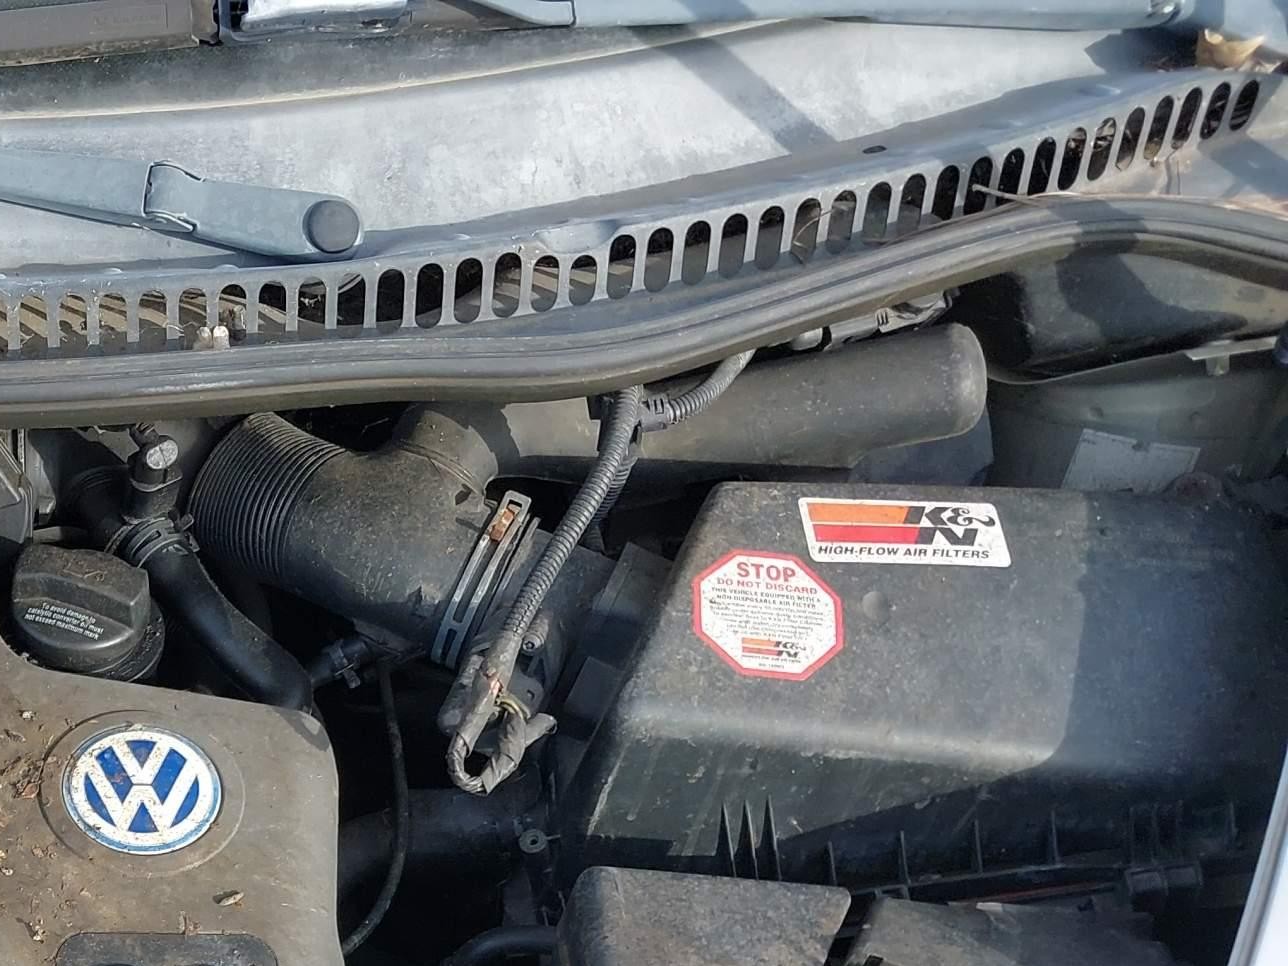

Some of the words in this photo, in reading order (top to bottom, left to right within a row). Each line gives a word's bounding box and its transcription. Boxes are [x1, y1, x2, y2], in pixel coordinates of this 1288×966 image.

[817, 545, 900, 556] HIGH-FLOW
[903, 547, 928, 557] AIR
[932, 548, 990, 559] FILTERS
[736, 561, 796, 582] STOP
[717, 577, 733, 586] DO
[737, 580, 762, 589] NOT
[765, 582, 818, 594] DISCARD
[729, 588, 758, 597] VEHICLE
[792, 601, 816, 609] FILTER
[49, 605, 67, 614] avoid
[66, 608, 89, 622] damage
[52, 613, 80, 625] converter
[24, 613, 35, 621] not
[35, 615, 56, 625] exceed
[83, 630, 100, 640] mark
